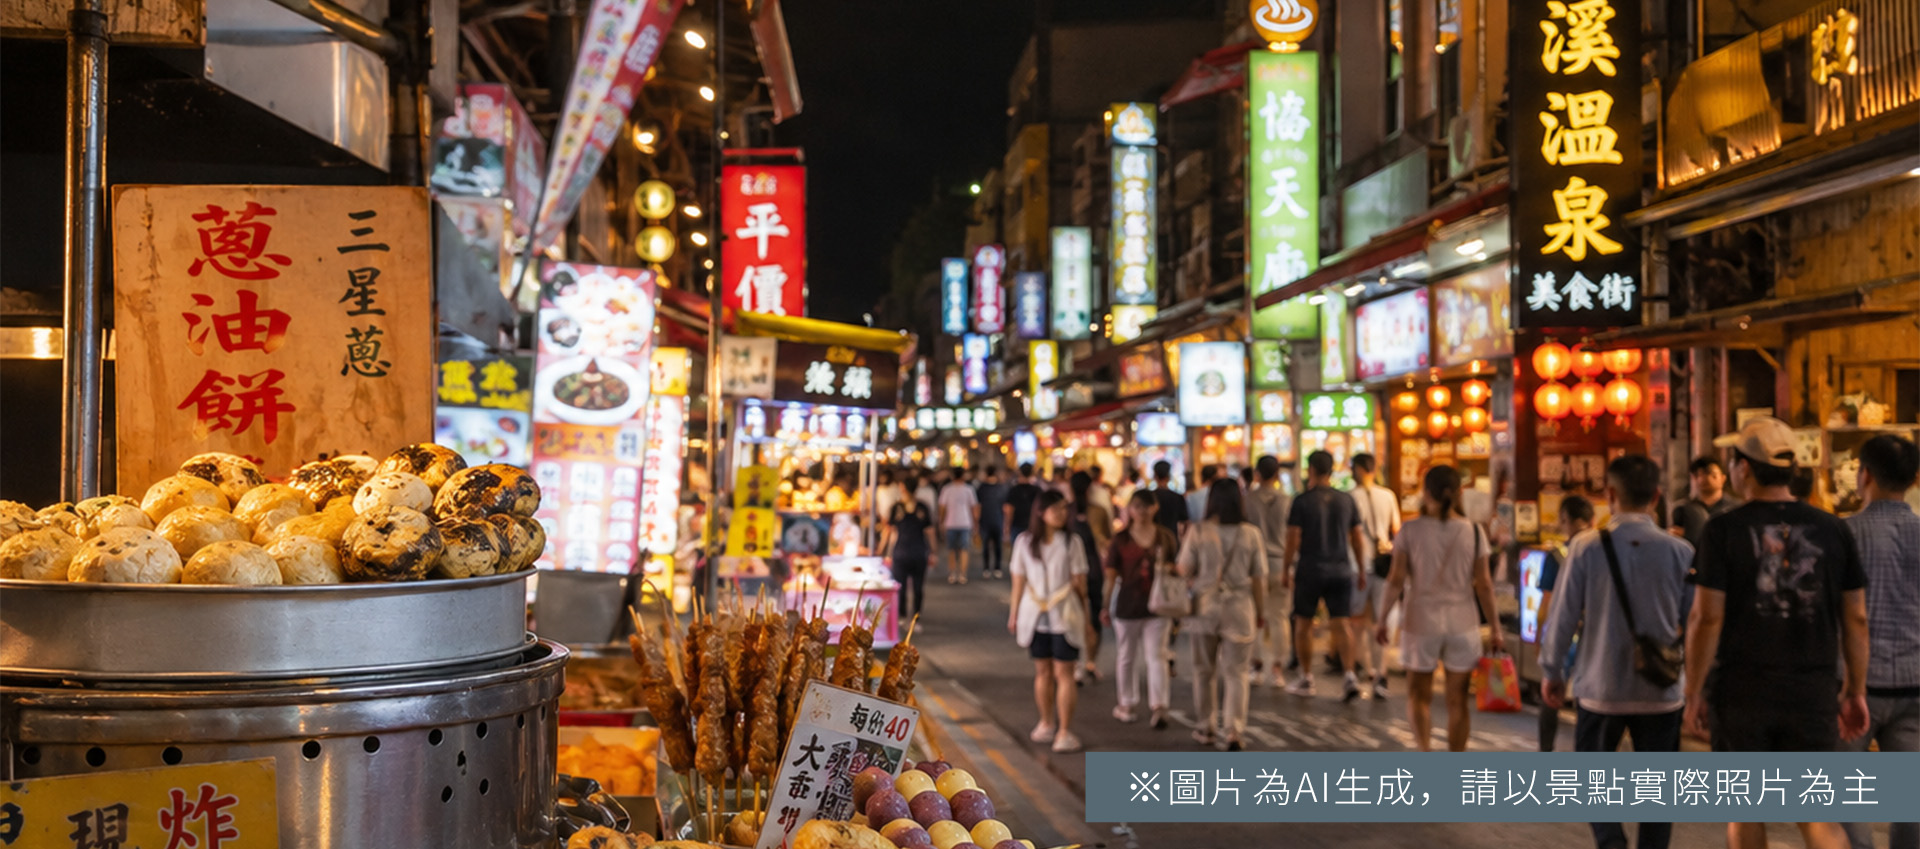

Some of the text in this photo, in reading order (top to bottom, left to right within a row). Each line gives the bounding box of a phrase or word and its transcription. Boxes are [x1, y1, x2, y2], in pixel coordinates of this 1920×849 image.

[177, 201, 297, 445] 蔥油餅
[337, 209, 392, 378] 三星蔥
[735, 202, 790, 316] 平價
[1526, 271, 1636, 312] 美食街
